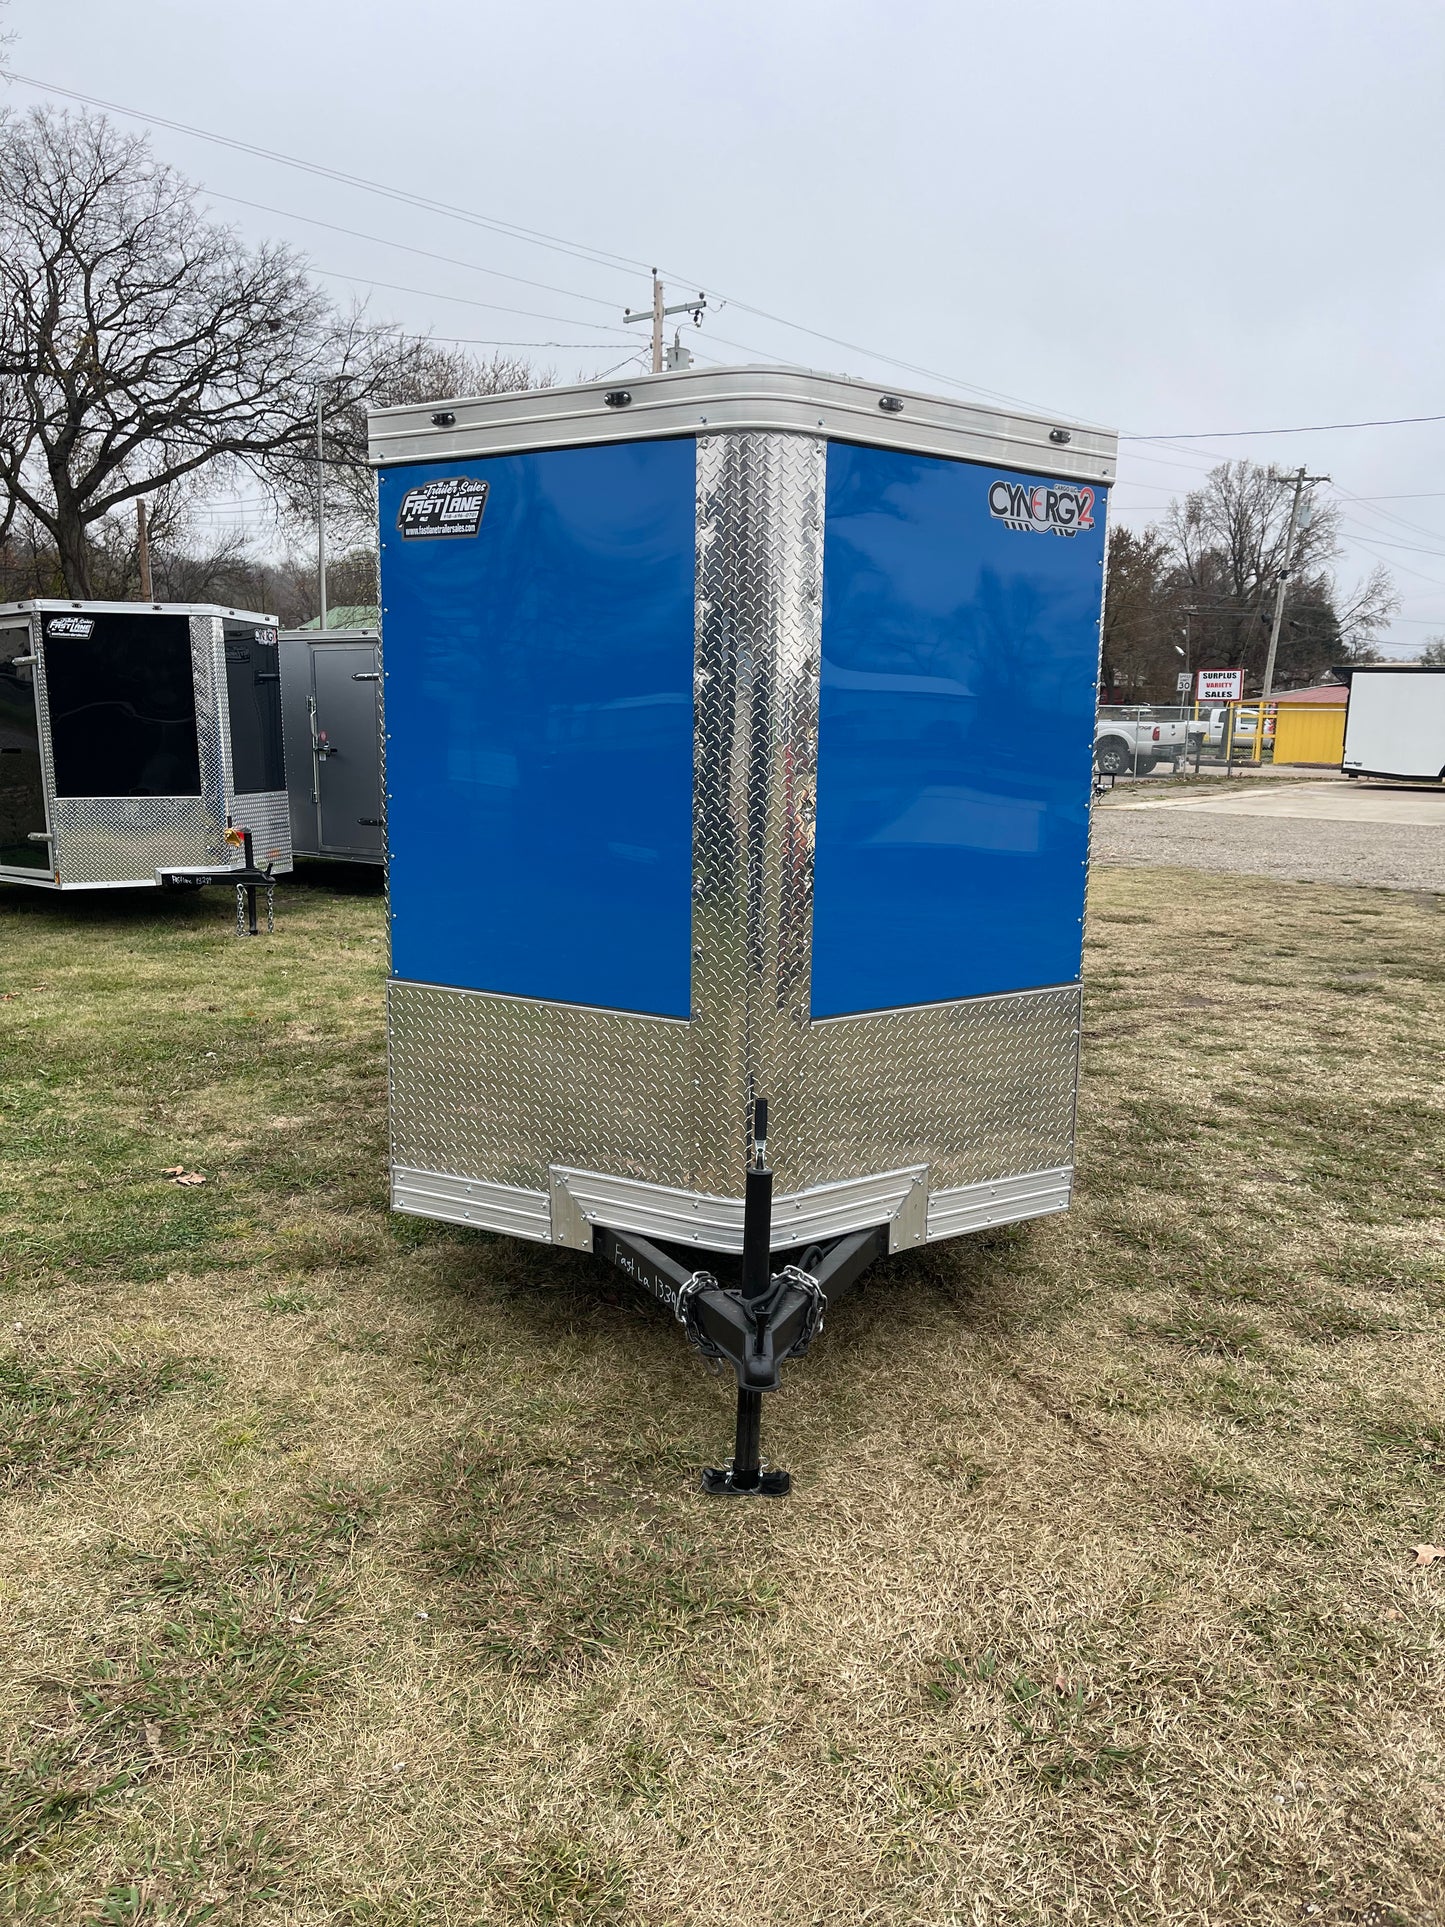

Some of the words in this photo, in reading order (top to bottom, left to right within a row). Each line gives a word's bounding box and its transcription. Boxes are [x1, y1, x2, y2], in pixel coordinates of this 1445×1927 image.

[426, 484, 458, 496] Trailer
[460, 481, 487, 494] Sales
[405, 523, 475, 535] www.fastlanetrailersales.com
[615, 1243, 635, 1276] Fast
